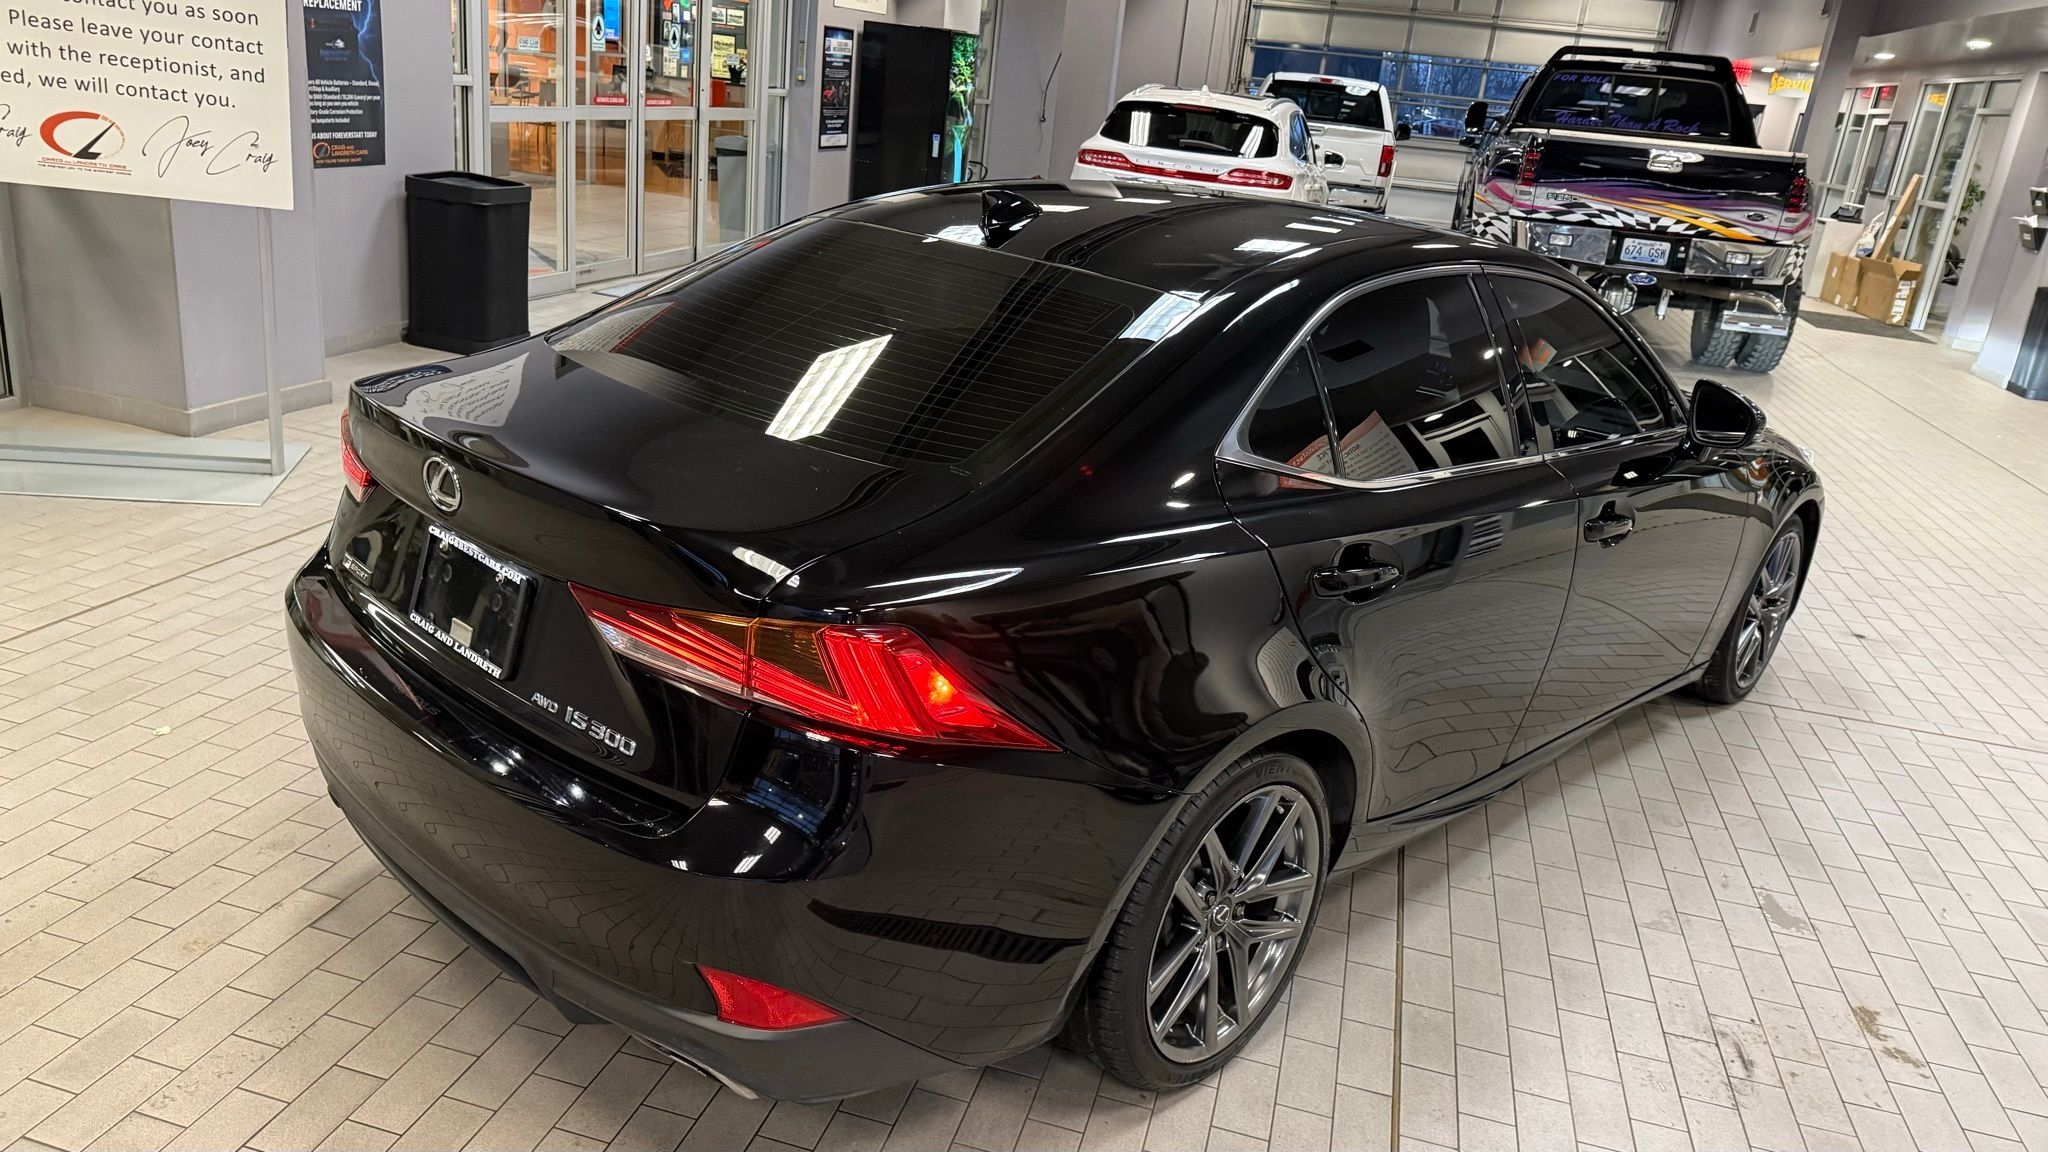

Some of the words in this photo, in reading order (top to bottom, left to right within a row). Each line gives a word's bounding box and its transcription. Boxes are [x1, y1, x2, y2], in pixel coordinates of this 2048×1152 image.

[142, 0, 178, 16] you
[185, 5, 205, 19] as
[212, 8, 258, 26] soon
[303, 0, 363, 12] REPLACEMENT
[9, 9, 74, 32] Please
[81, 17, 133, 39] leave
[140, 28, 184, 45] your
[191, 35, 264, 55] contact
[6, 40, 51, 59] with
[58, 44, 92, 63] the
[99, 53, 223, 81] receptionist,
[230, 67, 265, 84] and
[1553, 73, 1578, 82] FOR
[1580, 75, 1611, 84] SALE
[0, 68, 31, 88] ed,
[38, 74, 67, 89] we
[74, 77, 108, 94] will
[115, 83, 189, 103] contact
[195, 92, 236, 108] you.
[1608, 111, 1643, 130] Than
[1645, 118, 1662, 131] A
[1624, 245, 1643, 256] 674
[350, 563, 368, 580] SPORT
[428, 525, 522, 585] CRAIGSBESTCARS.COM
[409, 612, 435, 634] CRAIG
[434, 630, 453, 647] AND
[453, 642, 502, 679] LANDRETH
[531, 692, 559, 714] AWD
[564, 705, 589, 730] IS
[588, 720, 637, 757] 300
